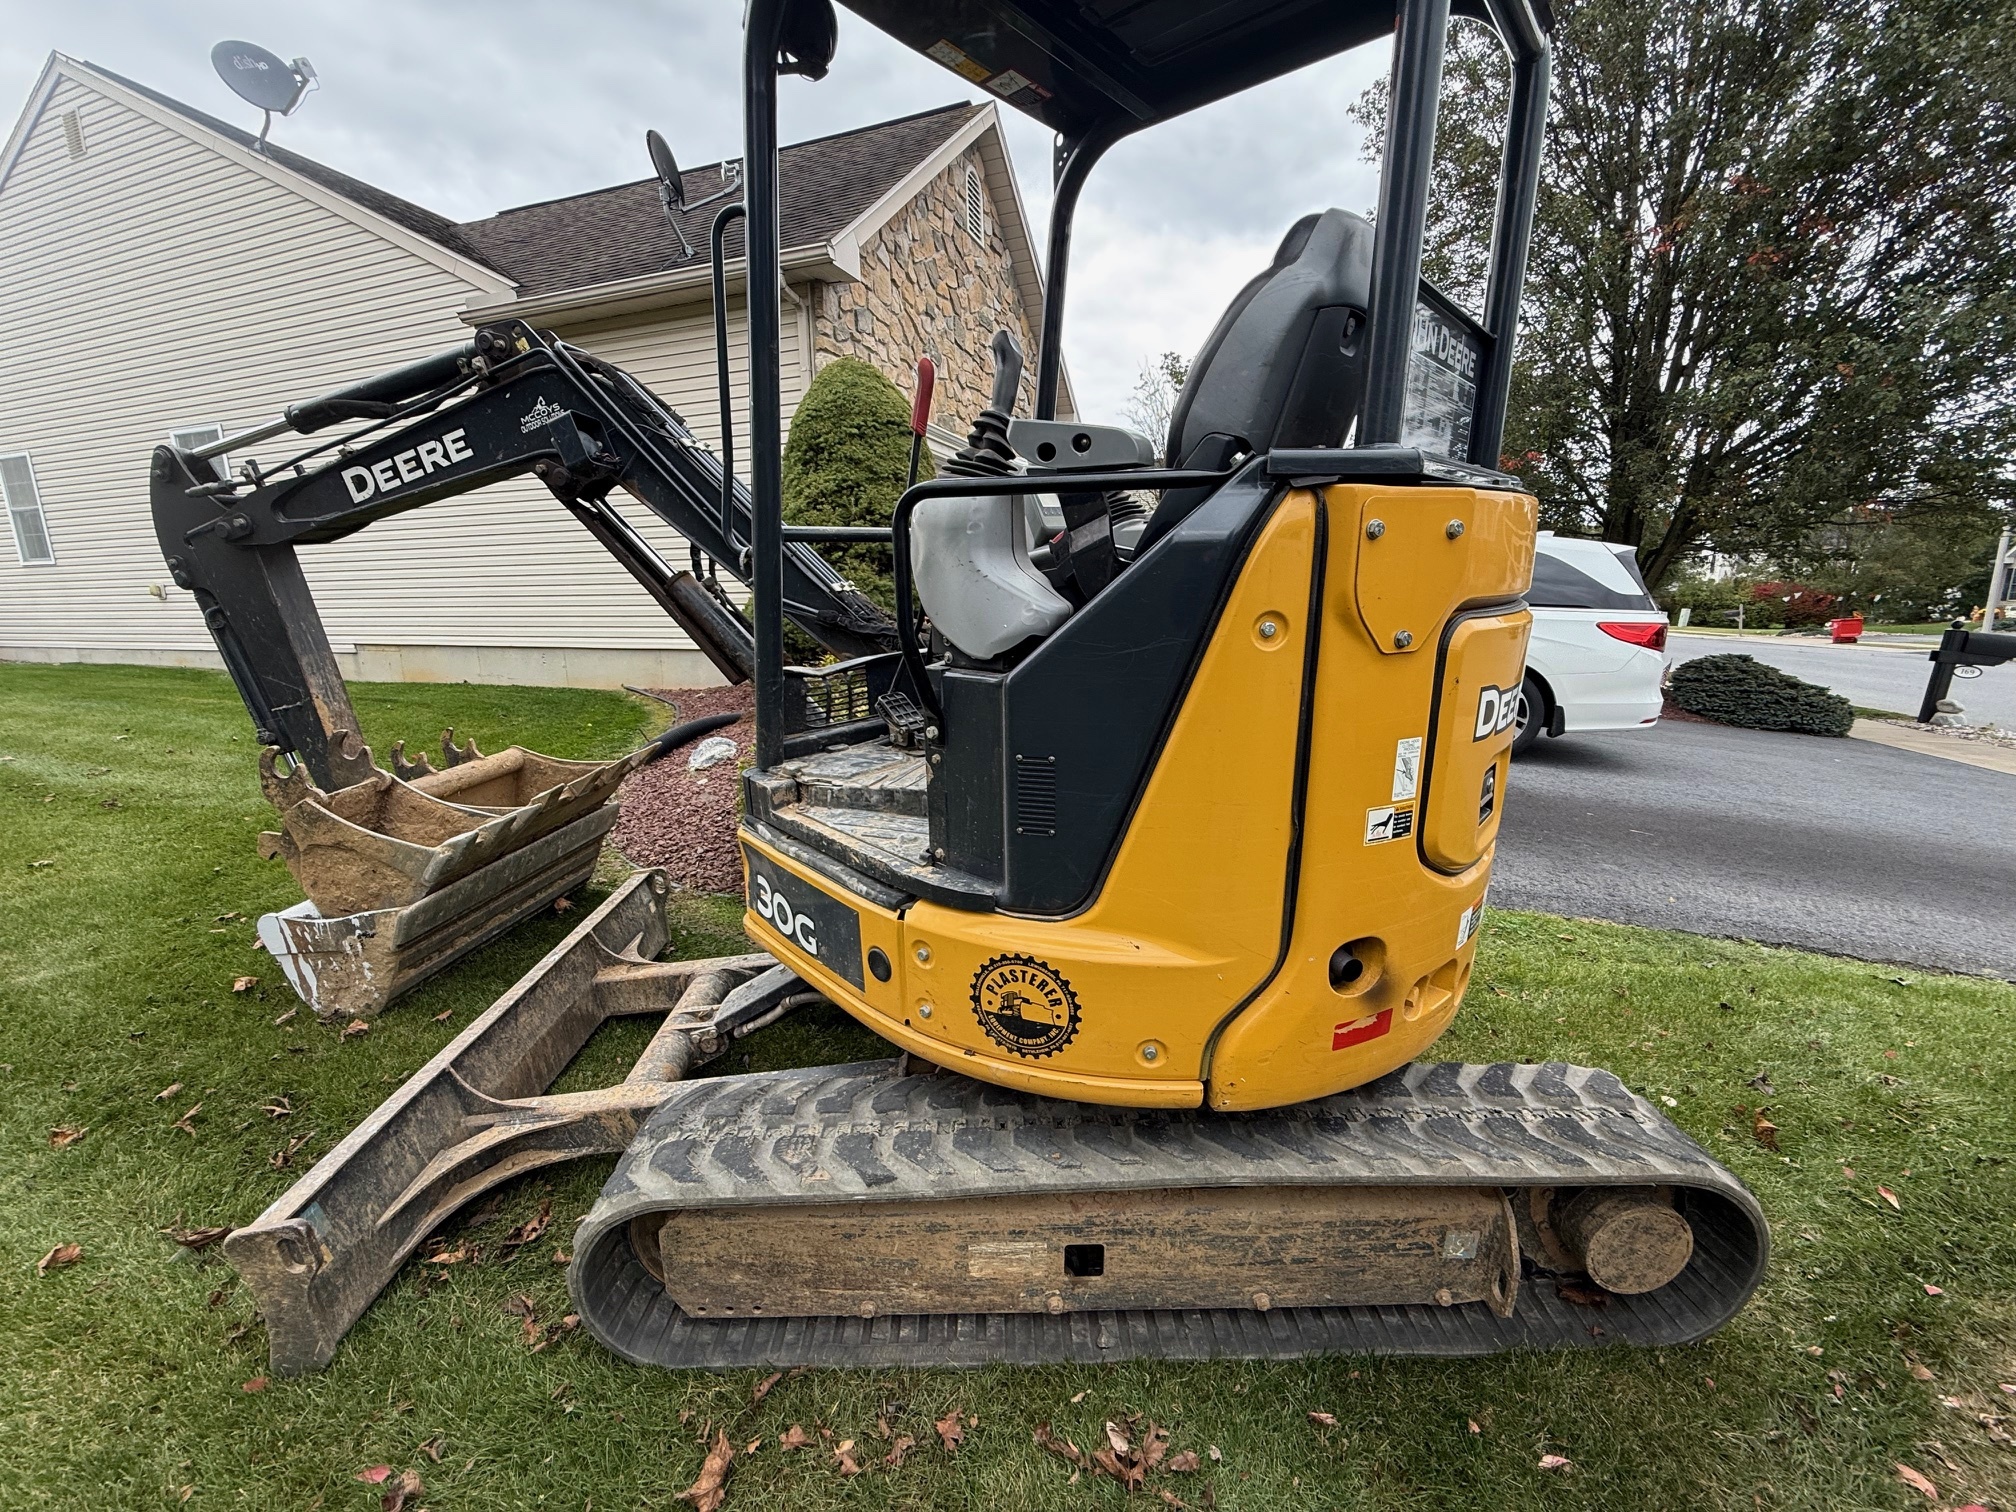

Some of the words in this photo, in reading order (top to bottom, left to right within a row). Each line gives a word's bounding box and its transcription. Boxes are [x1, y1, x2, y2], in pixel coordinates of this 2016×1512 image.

[233, 55, 255, 70] dish
[1438, 325, 1477, 379] DEERE
[521, 402, 560, 425] MCCOYS
[340, 427, 475, 504] DEERE
[757, 874, 818, 955] 30G
[986, 969, 1063, 1008] PLASTERER
[988, 1014, 1018, 1042] EQUIPMENT
